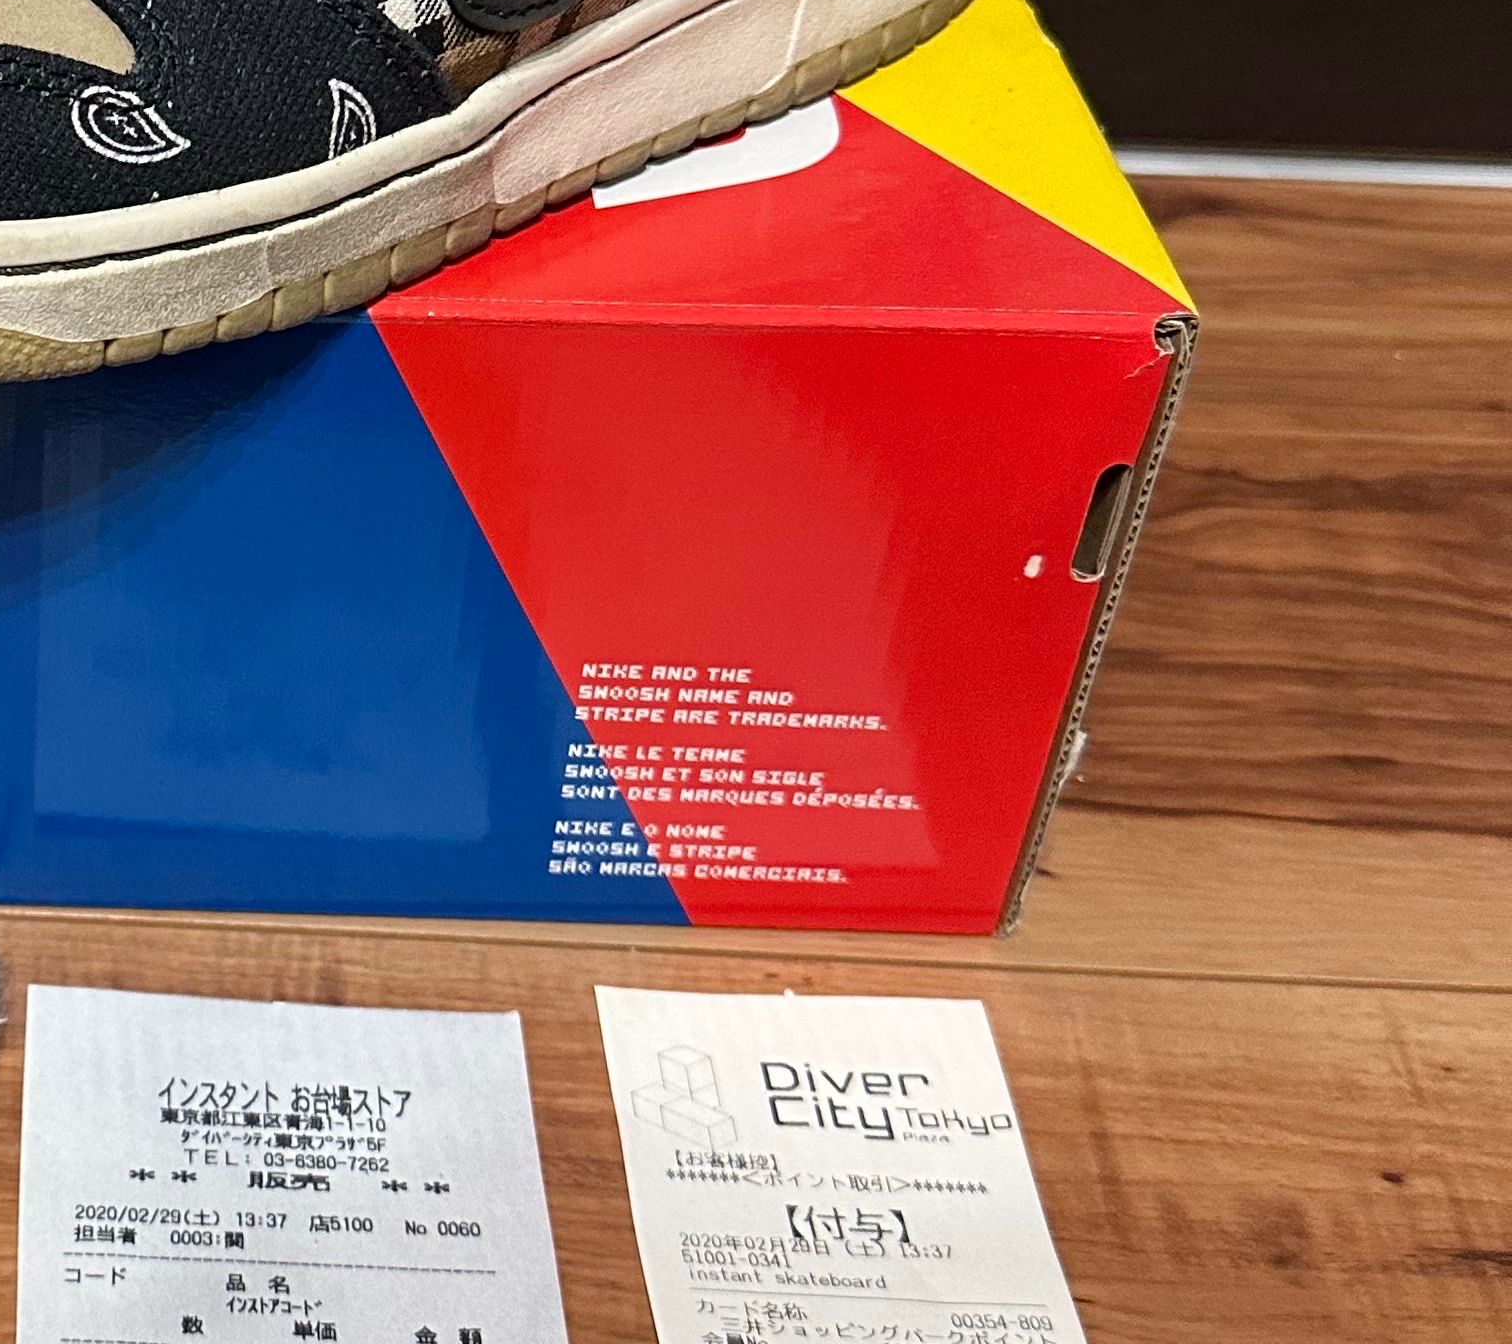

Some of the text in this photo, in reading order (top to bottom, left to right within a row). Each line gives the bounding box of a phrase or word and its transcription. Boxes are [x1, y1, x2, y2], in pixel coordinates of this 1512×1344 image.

[582, 664, 751, 683] NIKE AND THE
[579, 685, 793, 706] SWOOSH NAME AND
[575, 707, 887, 731] STRIPE ARE TRADEMARKS.
[568, 745, 627, 760] NIKE
[636, 746, 663, 761] LE
[565, 765, 825, 787] SWOOSH ET SON SIGLE
[561, 785, 921, 810] SONT DES MARQUES DÉPOSÉES.
[555, 821, 612, 836] NIKE
[621, 822, 635, 836] E
[666, 824, 726, 840] NOME
[552, 841, 756, 861] SWOOSH E STRIPE
[548, 857, 849, 883] SÃO MARCAS COMERCIAIS.
[760, 1061, 929, 1097] Diver
[158, 1076, 411, 1118] インスタント お台場ストア
[769, 1095, 895, 1140] City
[264, 1152, 389, 1173] 03-6380-7262
[247, 1171, 330, 1192] 販売
[74, 1225, 138, 1245] 担当者
[235, 1212, 287, 1229] 13:37
[437, 1221, 481, 1238] 0060
[786, 1204, 910, 1244] 【付与】
[64, 1265, 128, 1287] コード
[776, 1272, 887, 1289] skateboard
[292, 1319, 337, 1342] 単価
